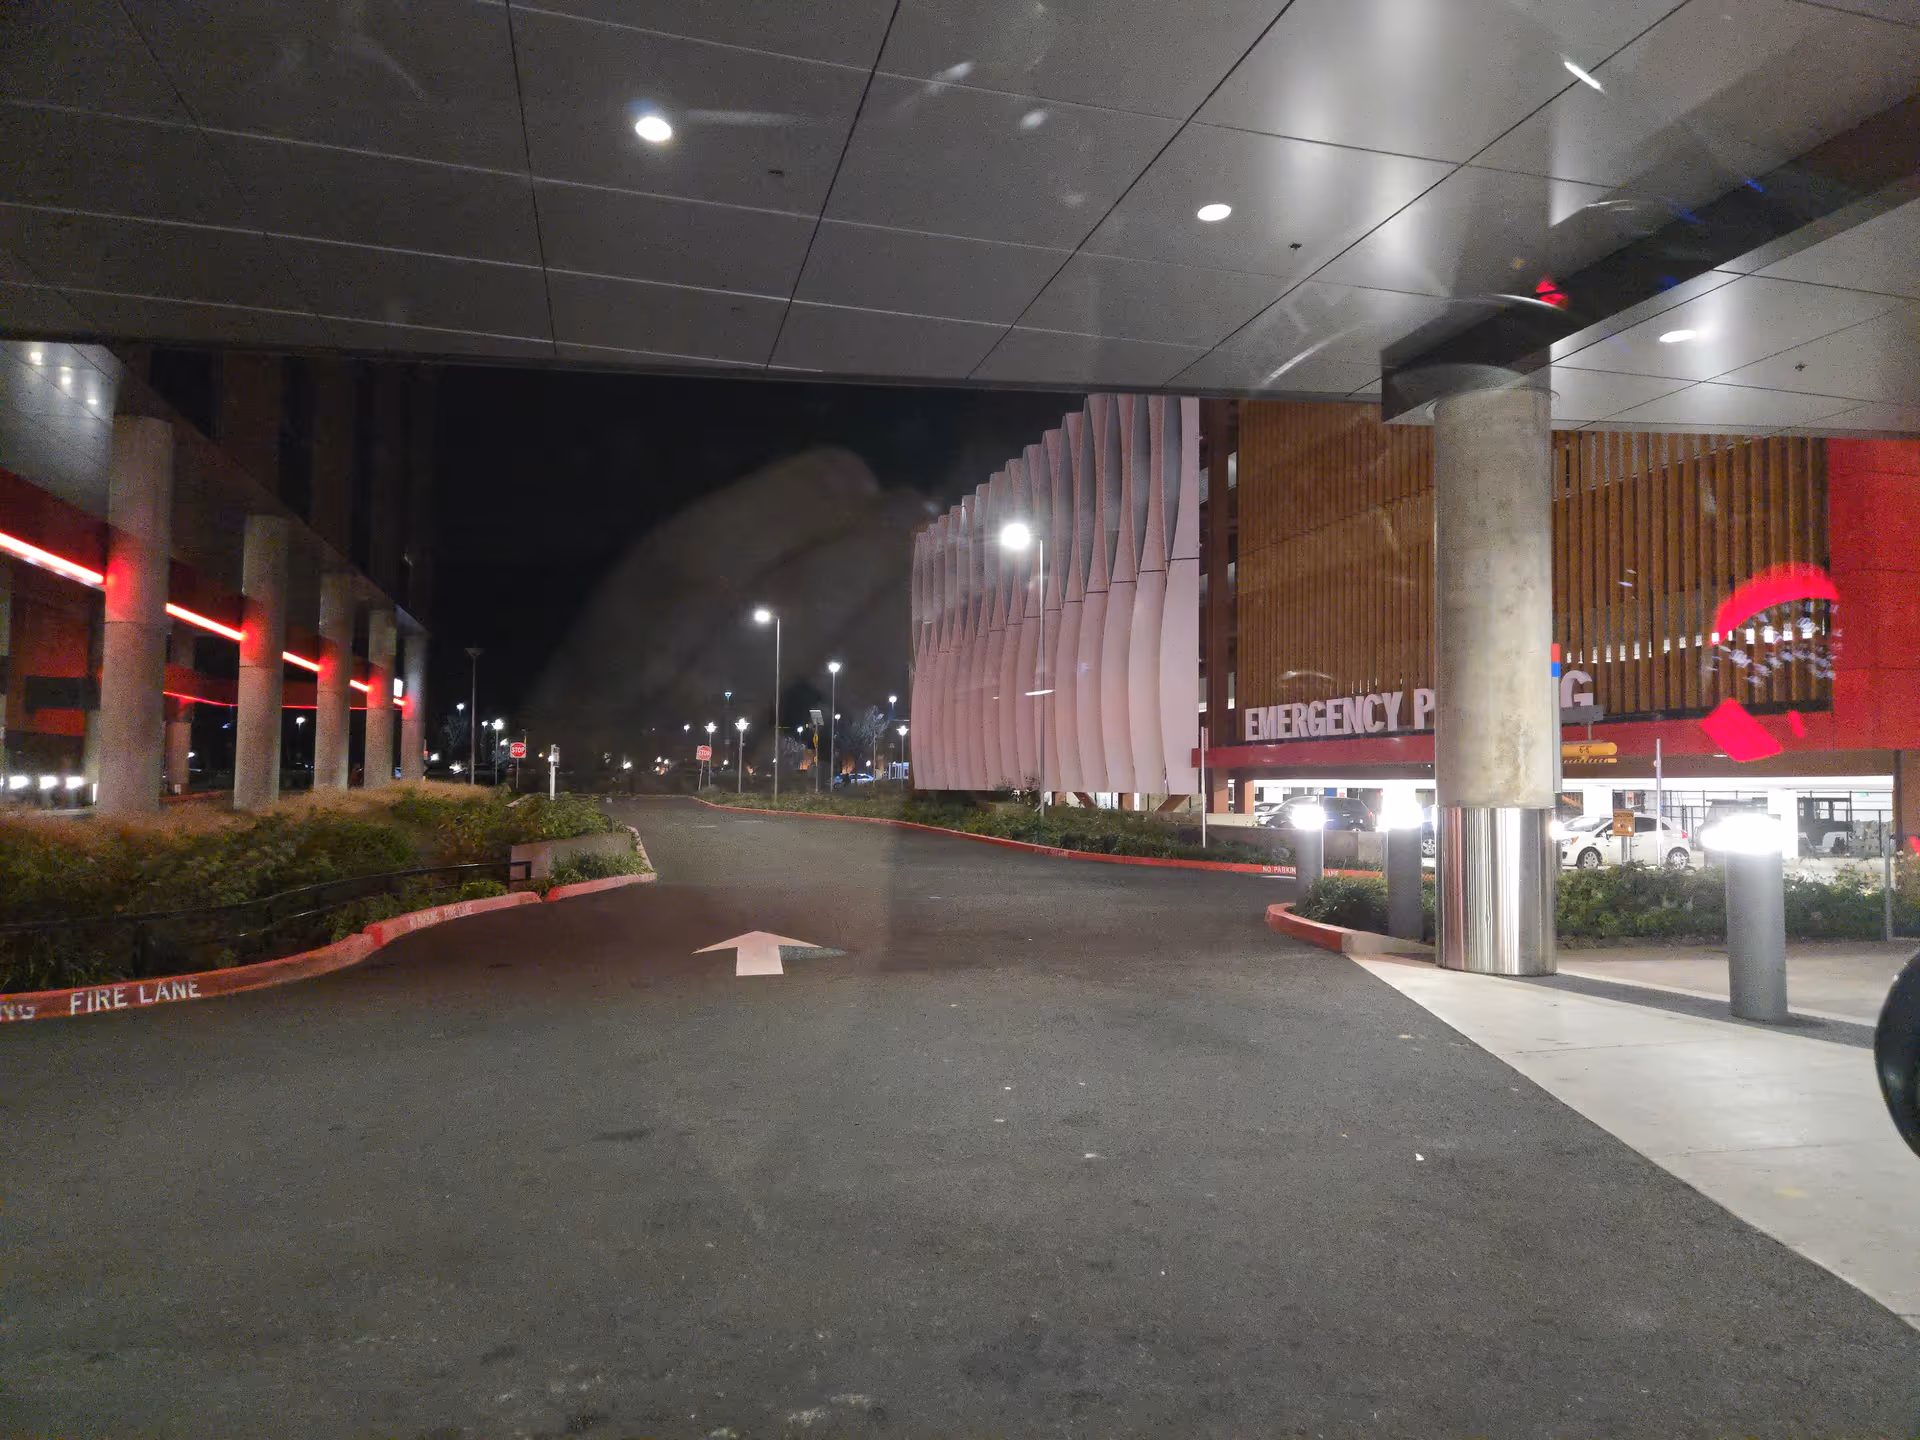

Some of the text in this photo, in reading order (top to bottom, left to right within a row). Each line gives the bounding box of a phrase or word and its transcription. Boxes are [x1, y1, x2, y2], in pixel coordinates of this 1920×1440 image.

[1244, 691, 1403, 741] EMERGENCY
[511, 746, 525, 754] STOP
[1273, 866, 1297, 874] PARKIN
[70, 986, 128, 1016] FIRE
[139, 977, 202, 1004] LANE
